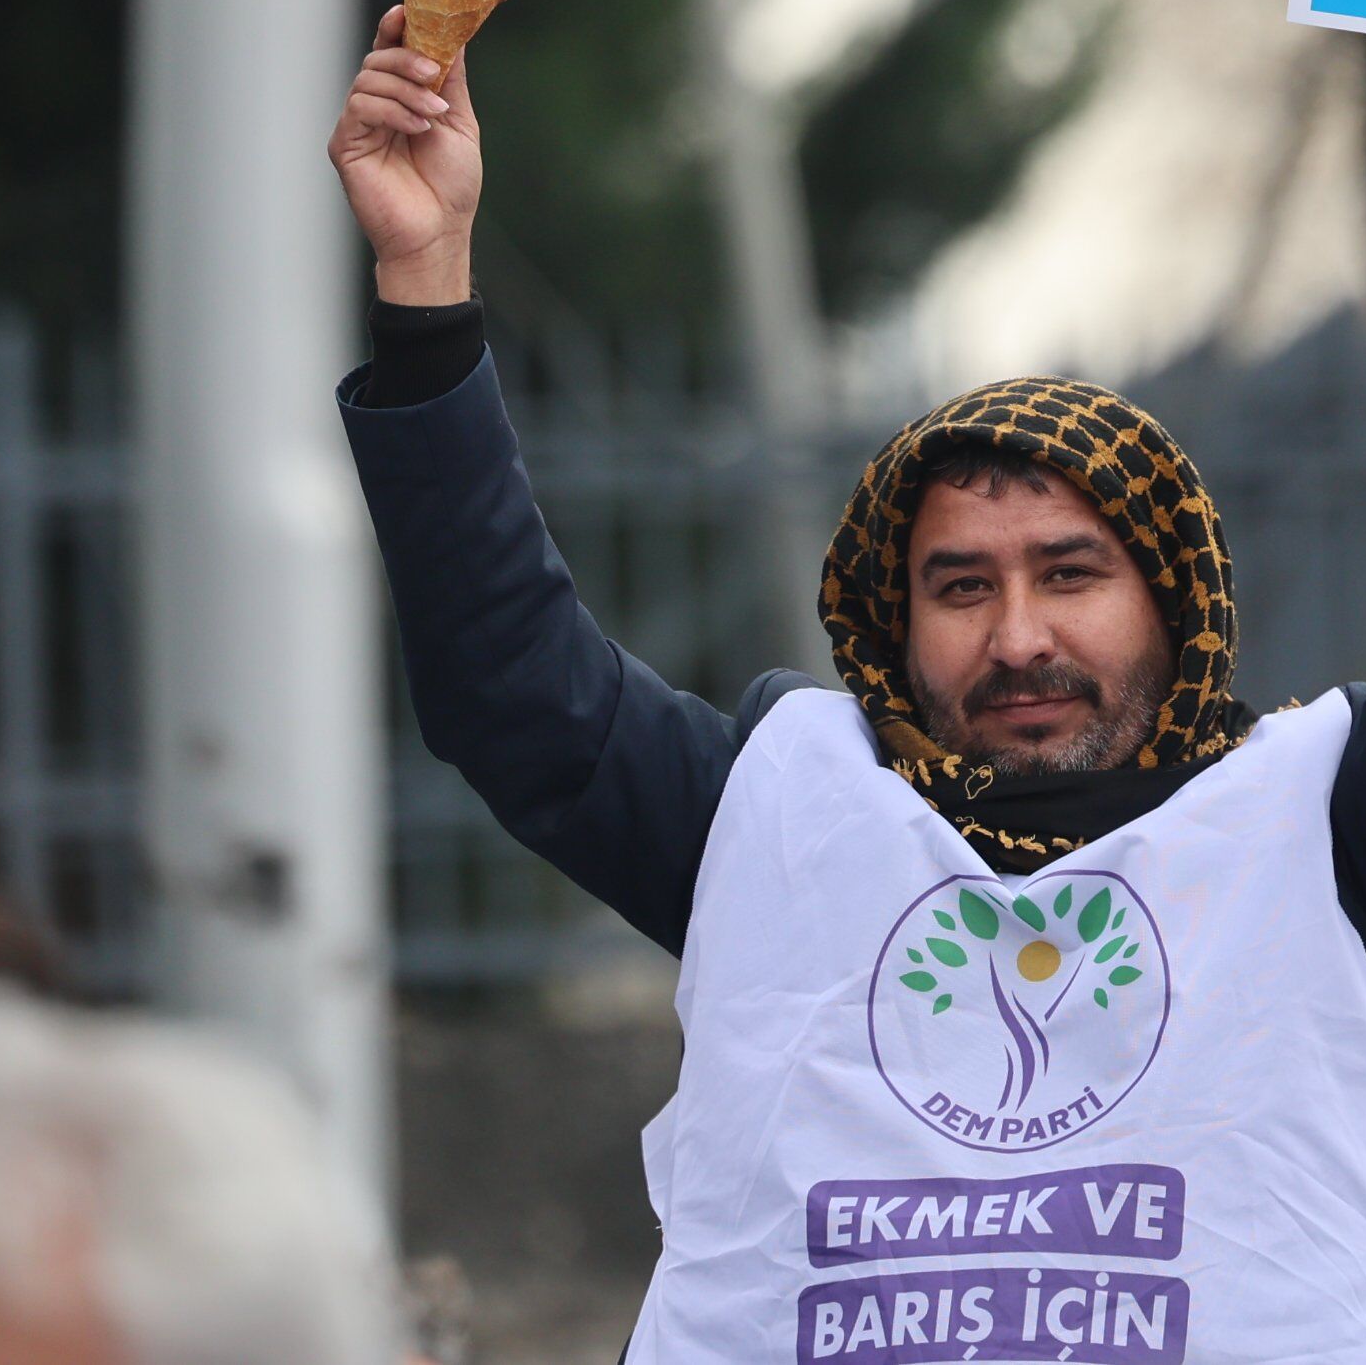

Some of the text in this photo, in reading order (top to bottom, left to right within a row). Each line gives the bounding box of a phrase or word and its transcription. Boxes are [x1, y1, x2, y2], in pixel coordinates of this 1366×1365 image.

[920, 1085, 1104, 1143] DEM PARTİ
[826, 1181, 1168, 1249] EKMEK VE
[812, 1267, 1169, 1362] BARIŞ İÇİN
